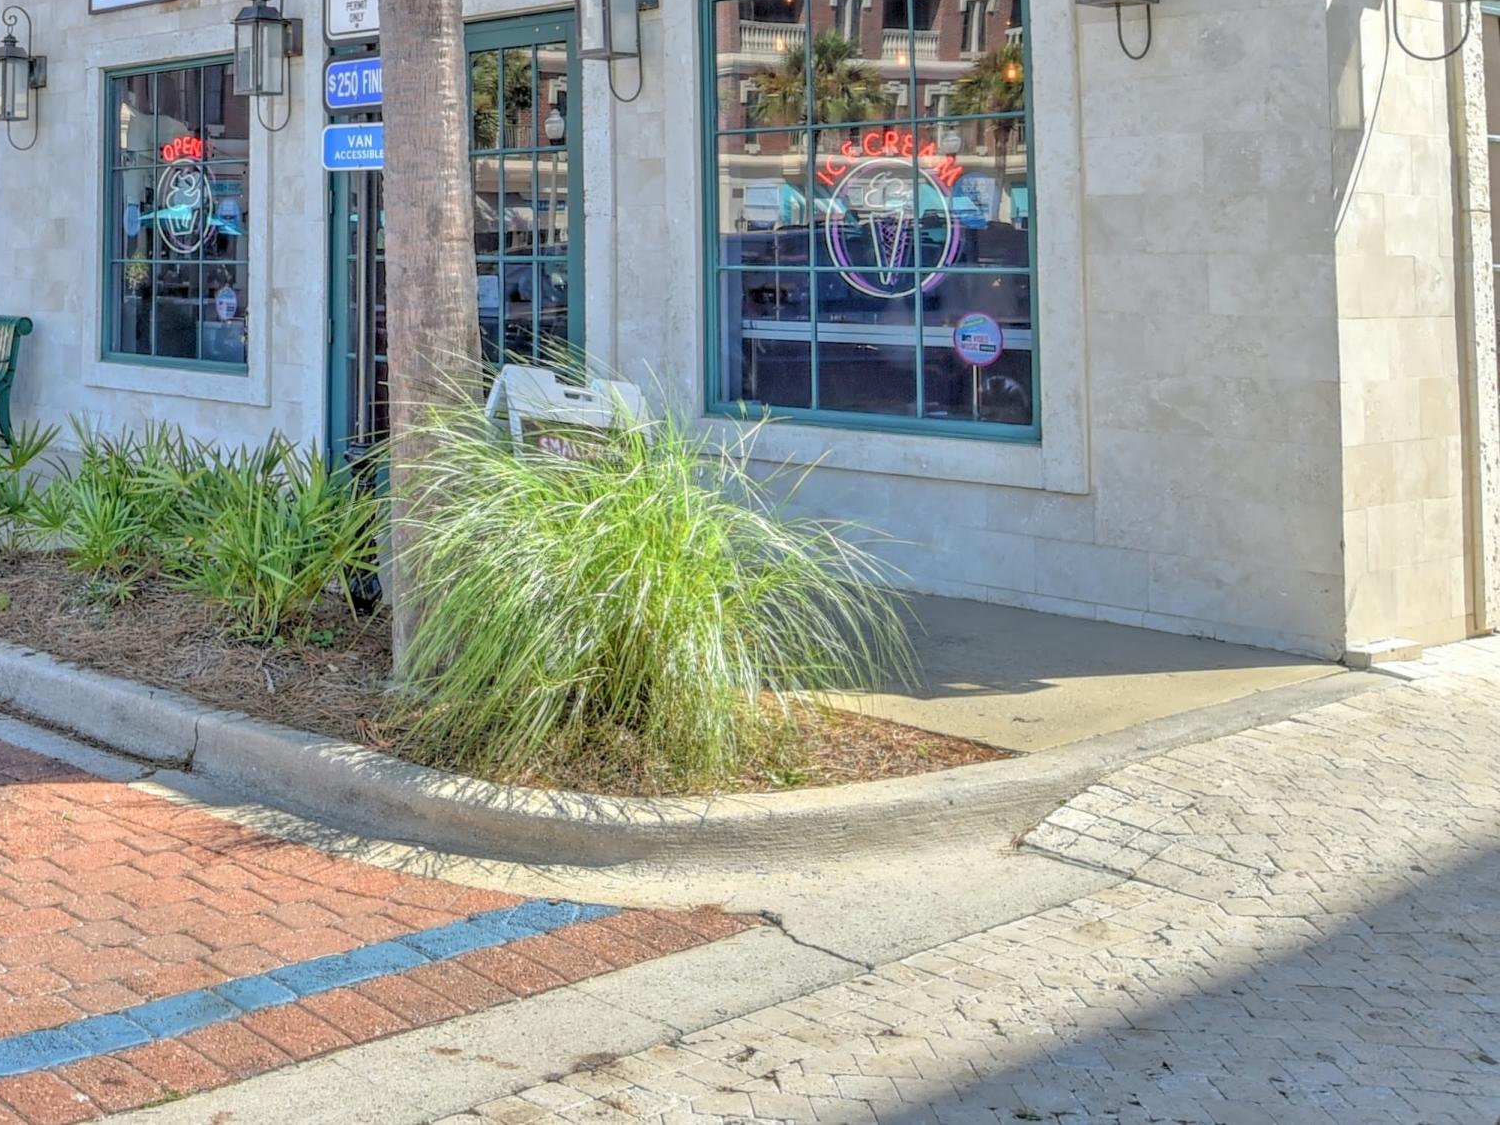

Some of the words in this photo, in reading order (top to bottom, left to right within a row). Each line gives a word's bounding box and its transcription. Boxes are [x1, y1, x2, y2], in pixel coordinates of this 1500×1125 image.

[346, 0, 367, 11] PERMIT
[349, 12, 365, 23] ONLY
[328, 71, 359, 97] $250
[362, 69, 383, 95] FIN
[163, 135, 203, 162] OPEN
[347, 134, 373, 148] VAN
[817, 140, 858, 186] ICE
[863, 130, 964, 187] CREAM
